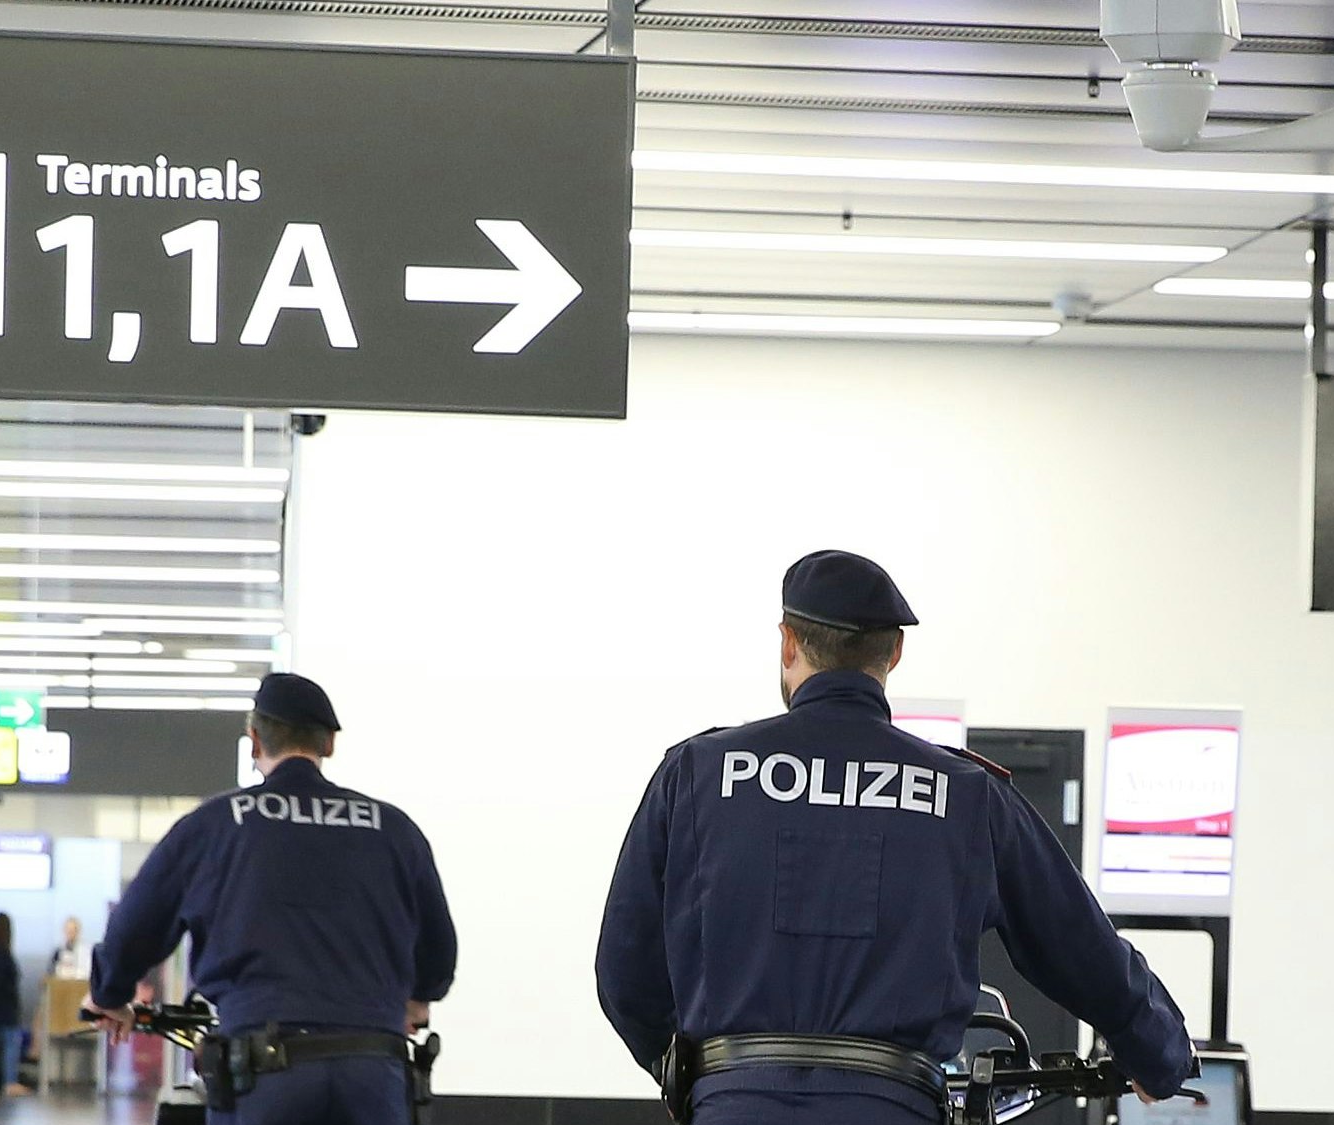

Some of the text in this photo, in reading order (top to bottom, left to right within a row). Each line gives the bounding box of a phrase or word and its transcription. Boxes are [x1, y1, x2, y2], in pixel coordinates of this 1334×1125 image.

[36, 154, 262, 202] Terminals
[721, 751, 949, 819] POLIZEI
[230, 791, 383, 831] POLIZEI
